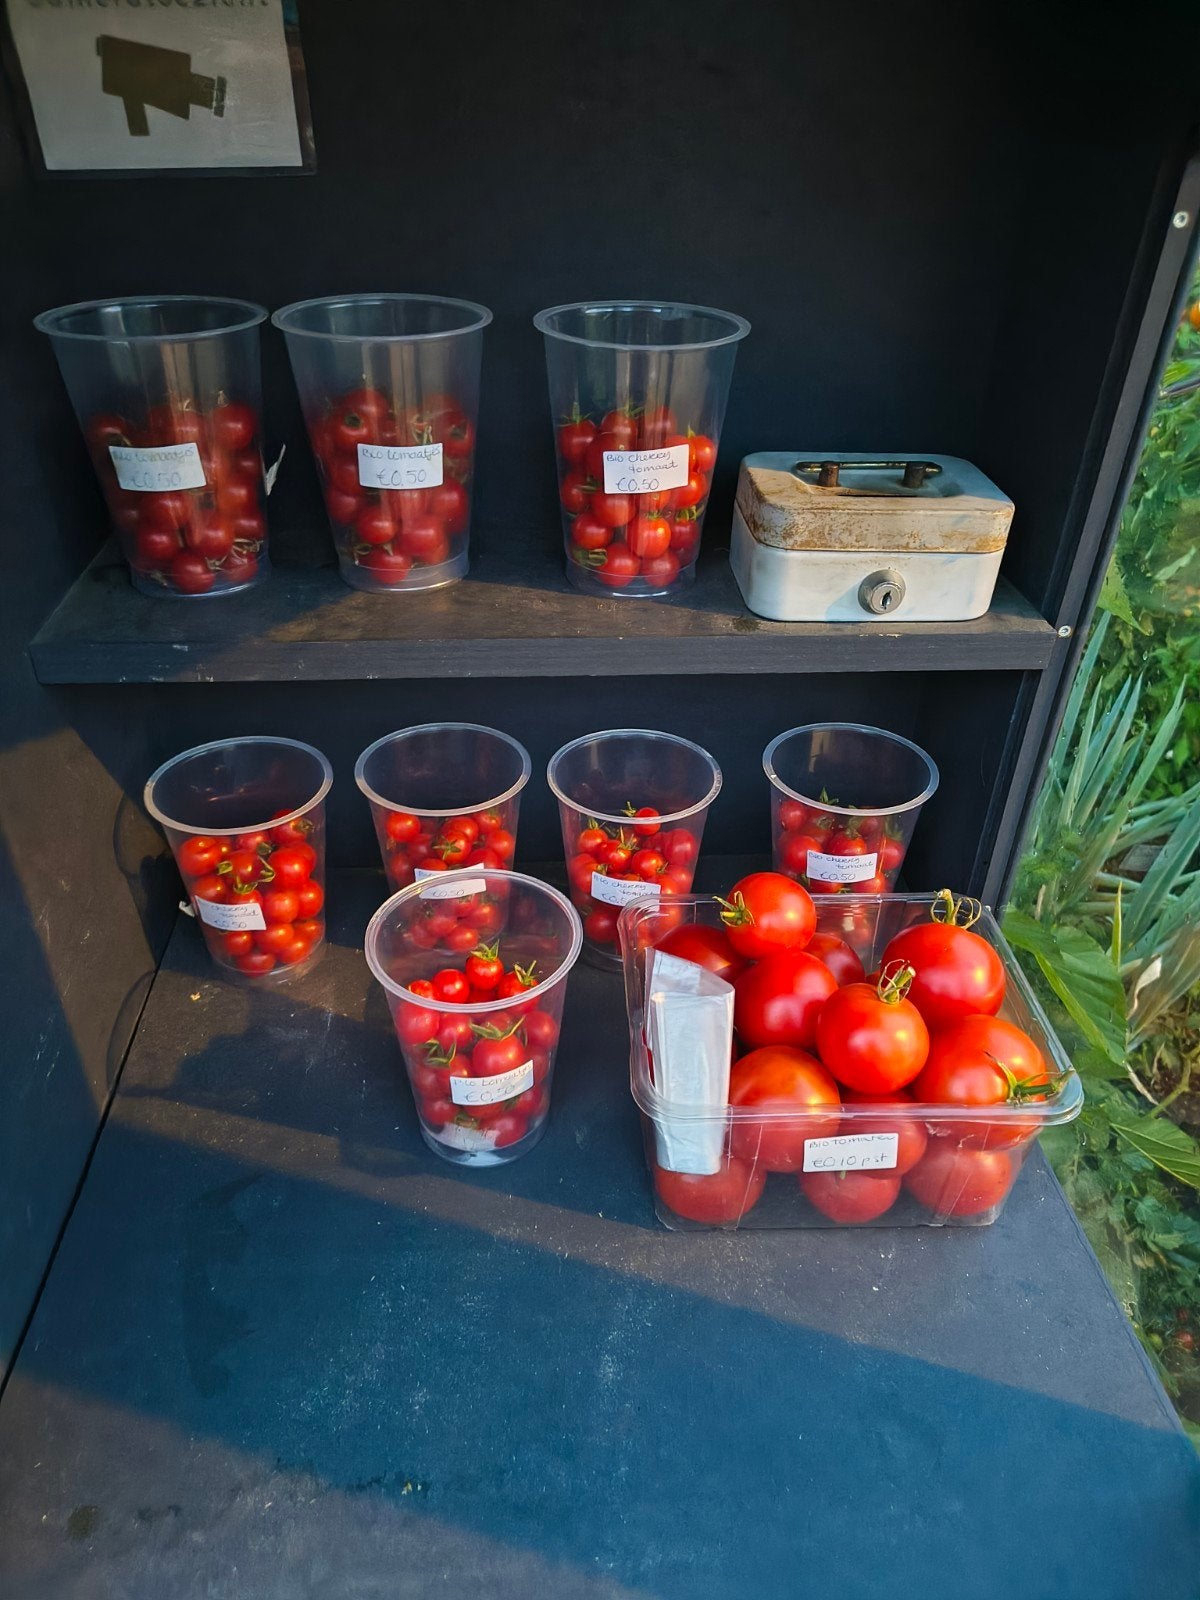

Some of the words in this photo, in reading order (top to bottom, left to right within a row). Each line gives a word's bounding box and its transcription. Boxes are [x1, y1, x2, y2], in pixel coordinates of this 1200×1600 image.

[131, 471, 182, 488] €050
[432, 889, 465, 897] €050
[213, 918, 247, 929] €050
